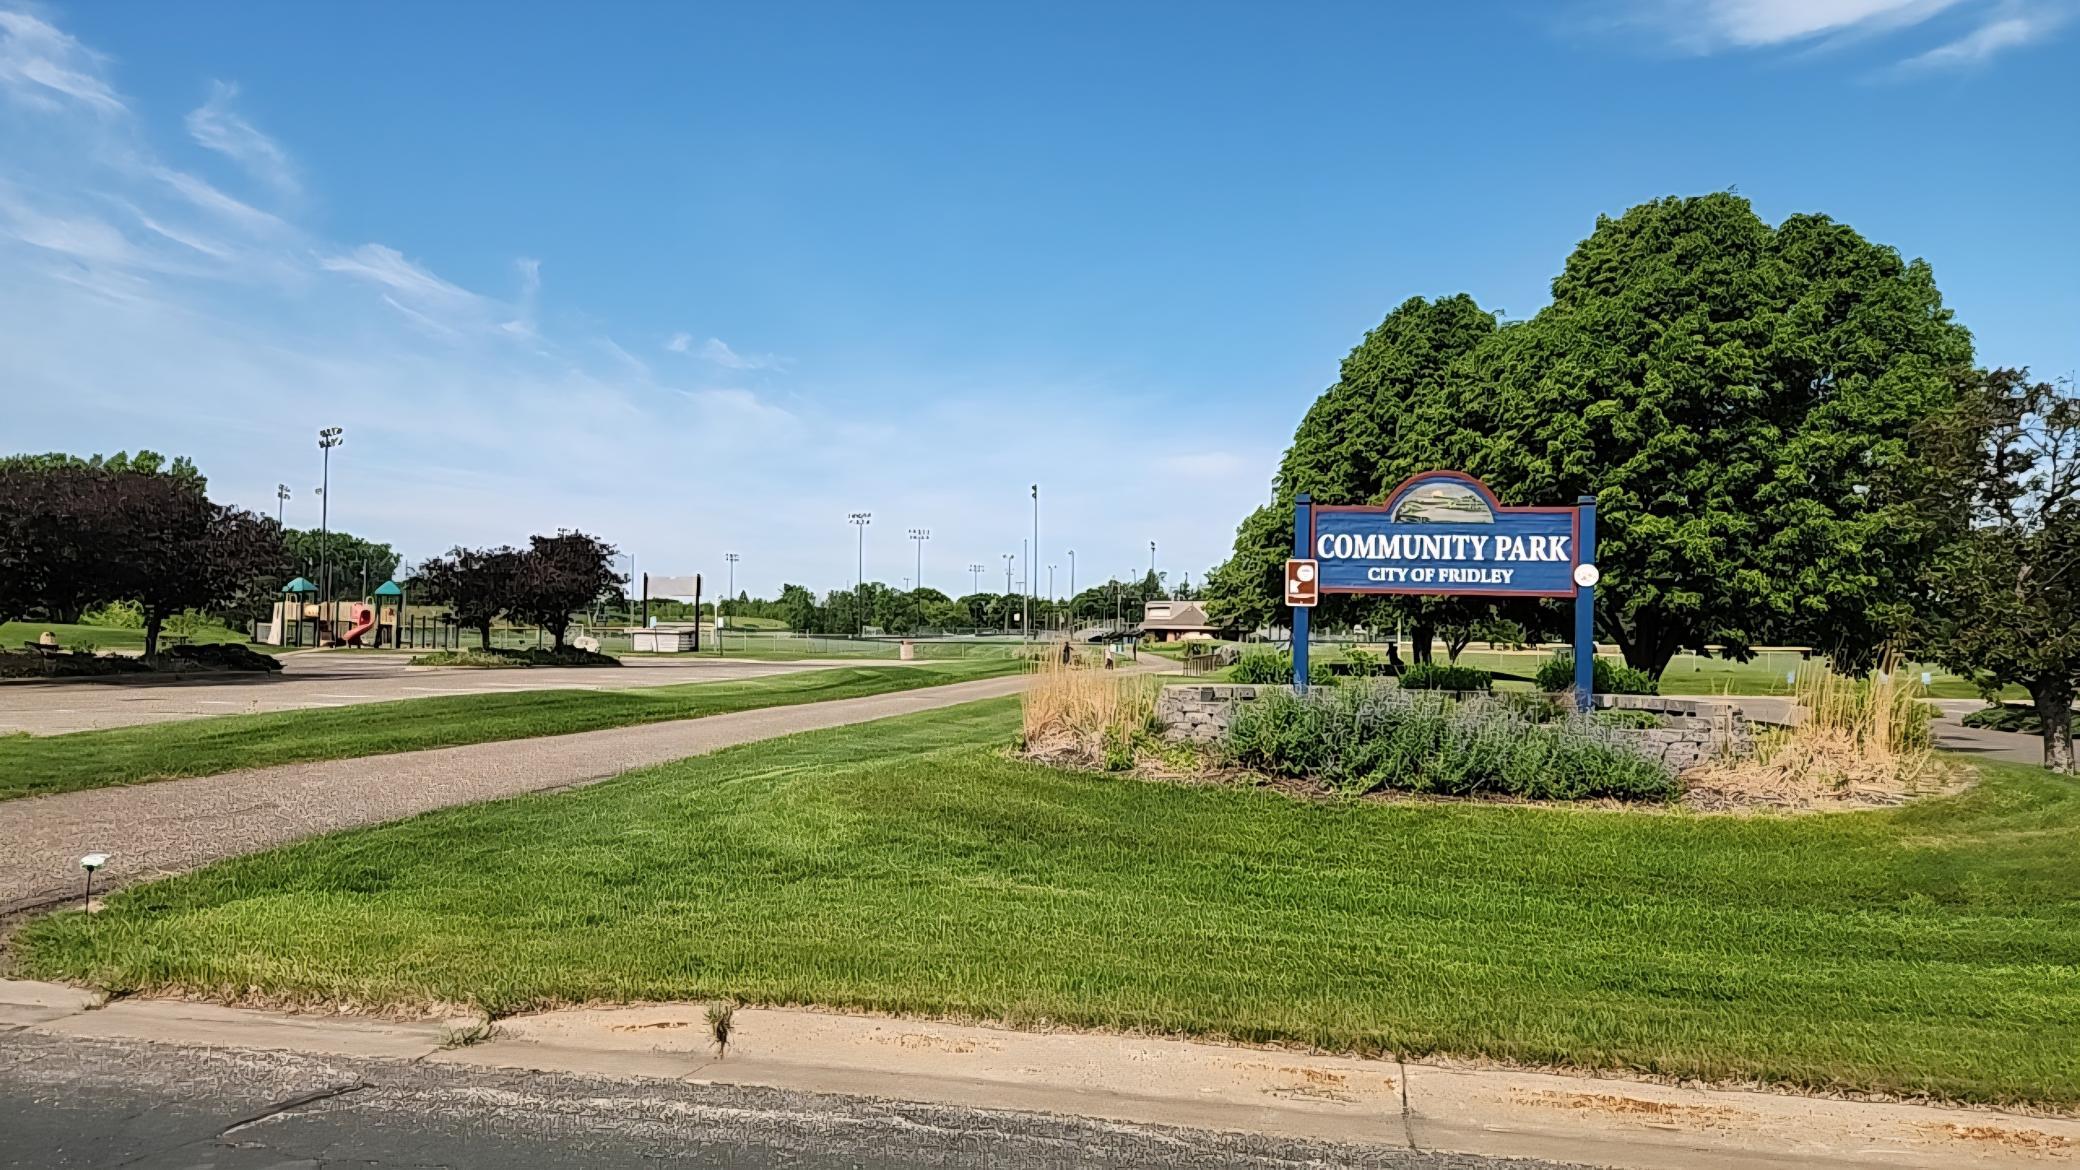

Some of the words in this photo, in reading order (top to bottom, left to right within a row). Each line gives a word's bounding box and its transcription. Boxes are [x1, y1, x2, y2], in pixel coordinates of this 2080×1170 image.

[1316, 533, 1488, 561] COMMUNITY
[1494, 535, 1570, 562] PARK
[1367, 567, 1408, 582] CITY
[1410, 568, 1435, 582] OF
[1438, 568, 1514, 584] FRIDLEY
